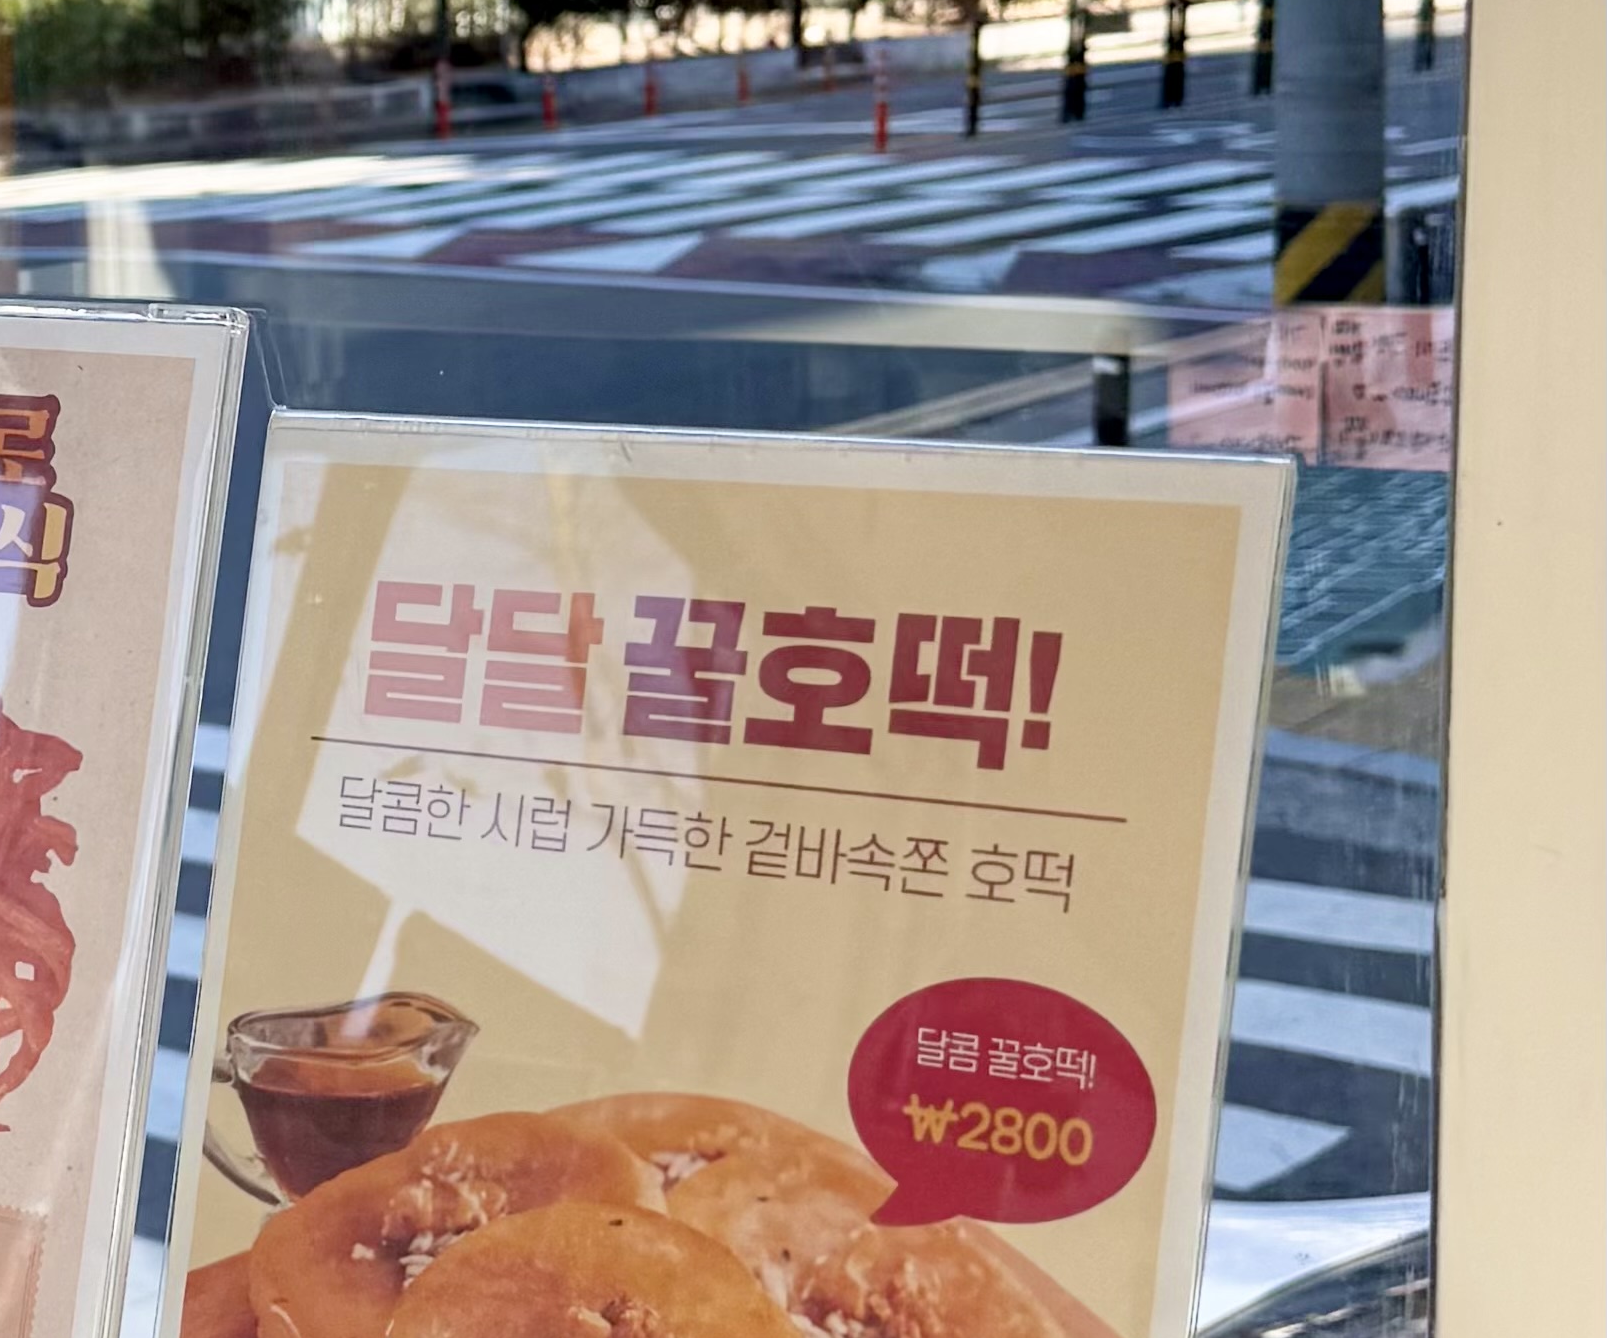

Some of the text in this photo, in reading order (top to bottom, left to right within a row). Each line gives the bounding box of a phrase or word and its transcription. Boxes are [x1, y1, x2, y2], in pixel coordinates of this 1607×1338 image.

[364, 580, 1065, 772] 달달 꿀호떡!
[337, 772, 1076, 915] 달콤한 시럽 가득한 겉바속쫀 호떡
[916, 1026, 1098, 1092] 달콤 꿀호떡!
[902, 1092, 1095, 1166] ₩2800
